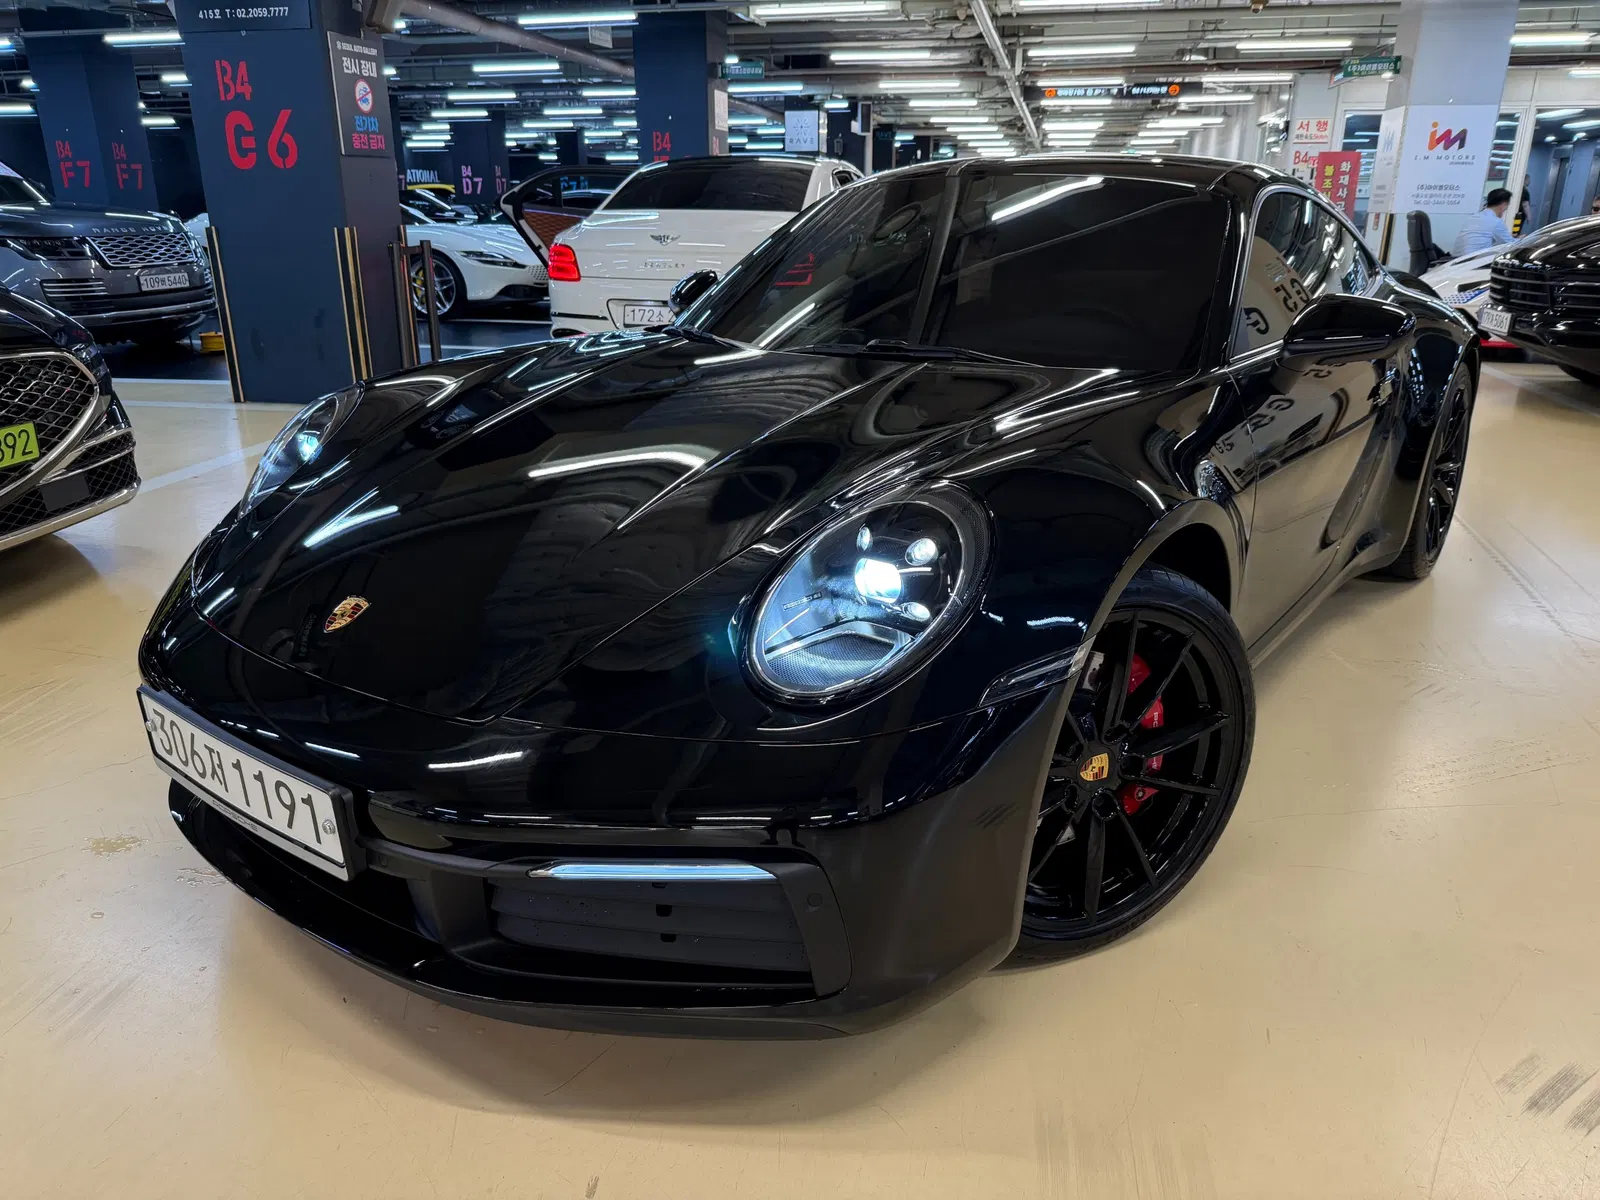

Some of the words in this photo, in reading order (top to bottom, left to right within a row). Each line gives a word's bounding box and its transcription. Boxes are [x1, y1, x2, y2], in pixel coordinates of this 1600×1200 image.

[342, 57, 359, 75] 전시
[215, 60, 252, 101] B4
[55, 140, 72, 159] B4
[653, 131, 671, 152] B4
[112, 142, 127, 160] B4
[1293, 151, 1309, 165] B4
[461, 165, 472, 177] B4
[463, 177, 483, 194] D7
